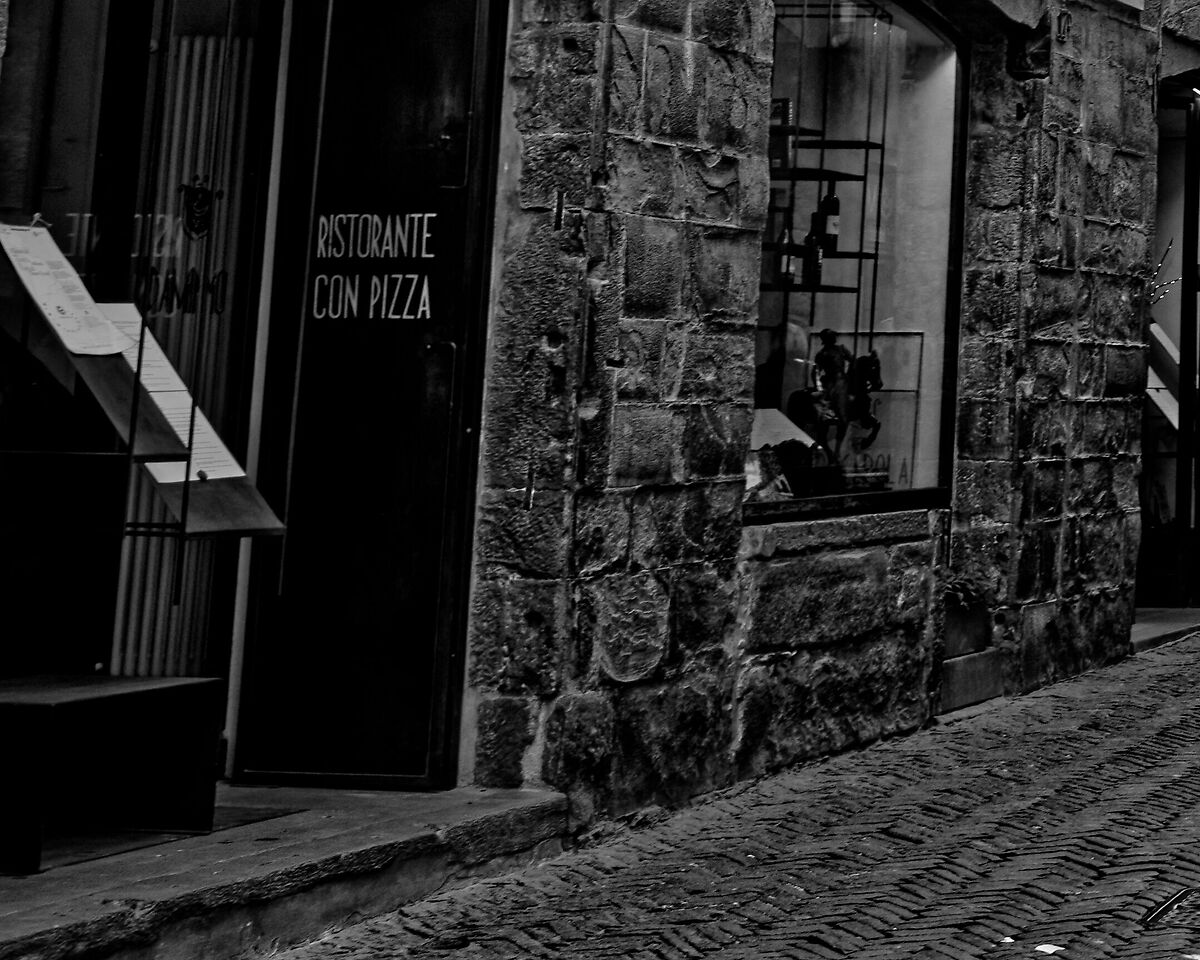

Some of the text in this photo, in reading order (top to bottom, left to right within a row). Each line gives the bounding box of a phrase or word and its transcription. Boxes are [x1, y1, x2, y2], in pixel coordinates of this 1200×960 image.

[316, 212, 437, 259] RISTORANTE
[313, 273, 431, 320] CON PIZZA
